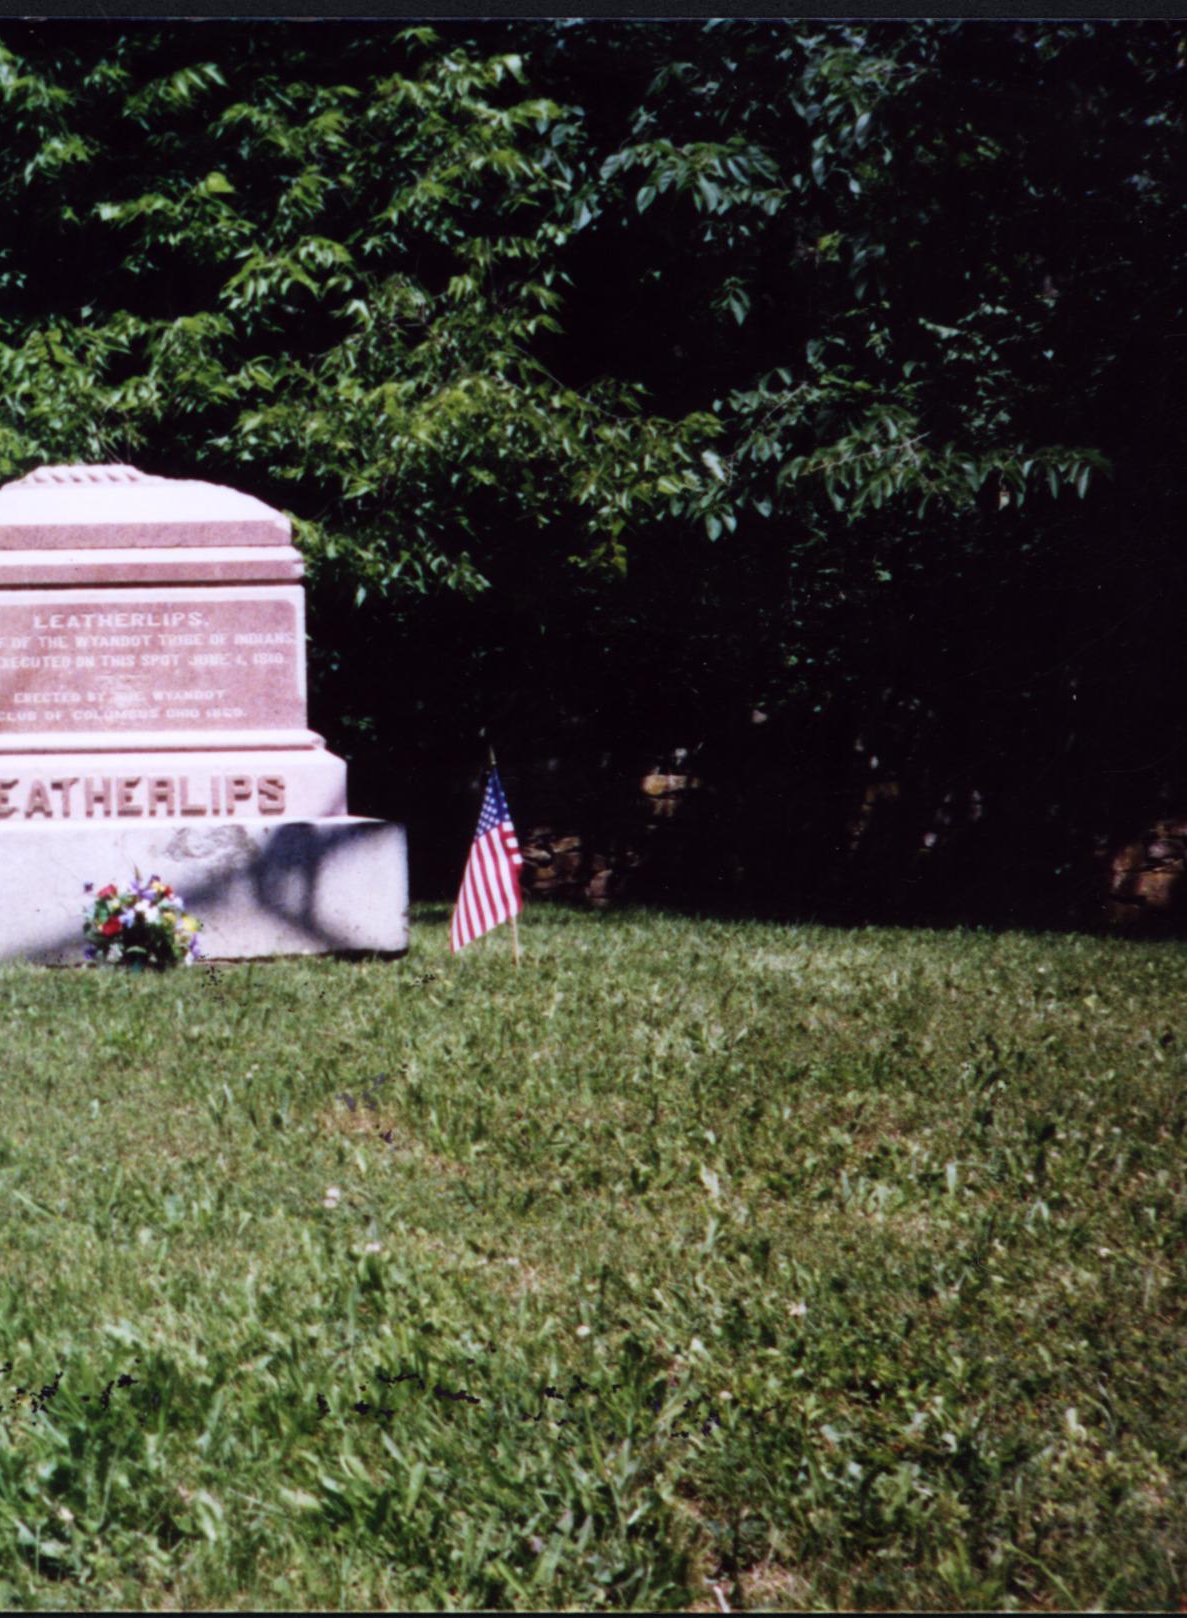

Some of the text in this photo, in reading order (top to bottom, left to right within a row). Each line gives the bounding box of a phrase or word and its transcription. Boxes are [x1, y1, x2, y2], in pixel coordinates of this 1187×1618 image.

[11, 636, 30, 649] OF
[39, 636, 68, 648] THE
[75, 634, 153, 648] WYANDOT
[158, 633, 203, 647] TRIBE
[209, 633, 227, 646] OF
[76, 655, 95, 668] ON
[101, 654, 135, 667] THIS
[140, 653, 180, 667] SPOT
[188, 652, 231, 666] JUNE
